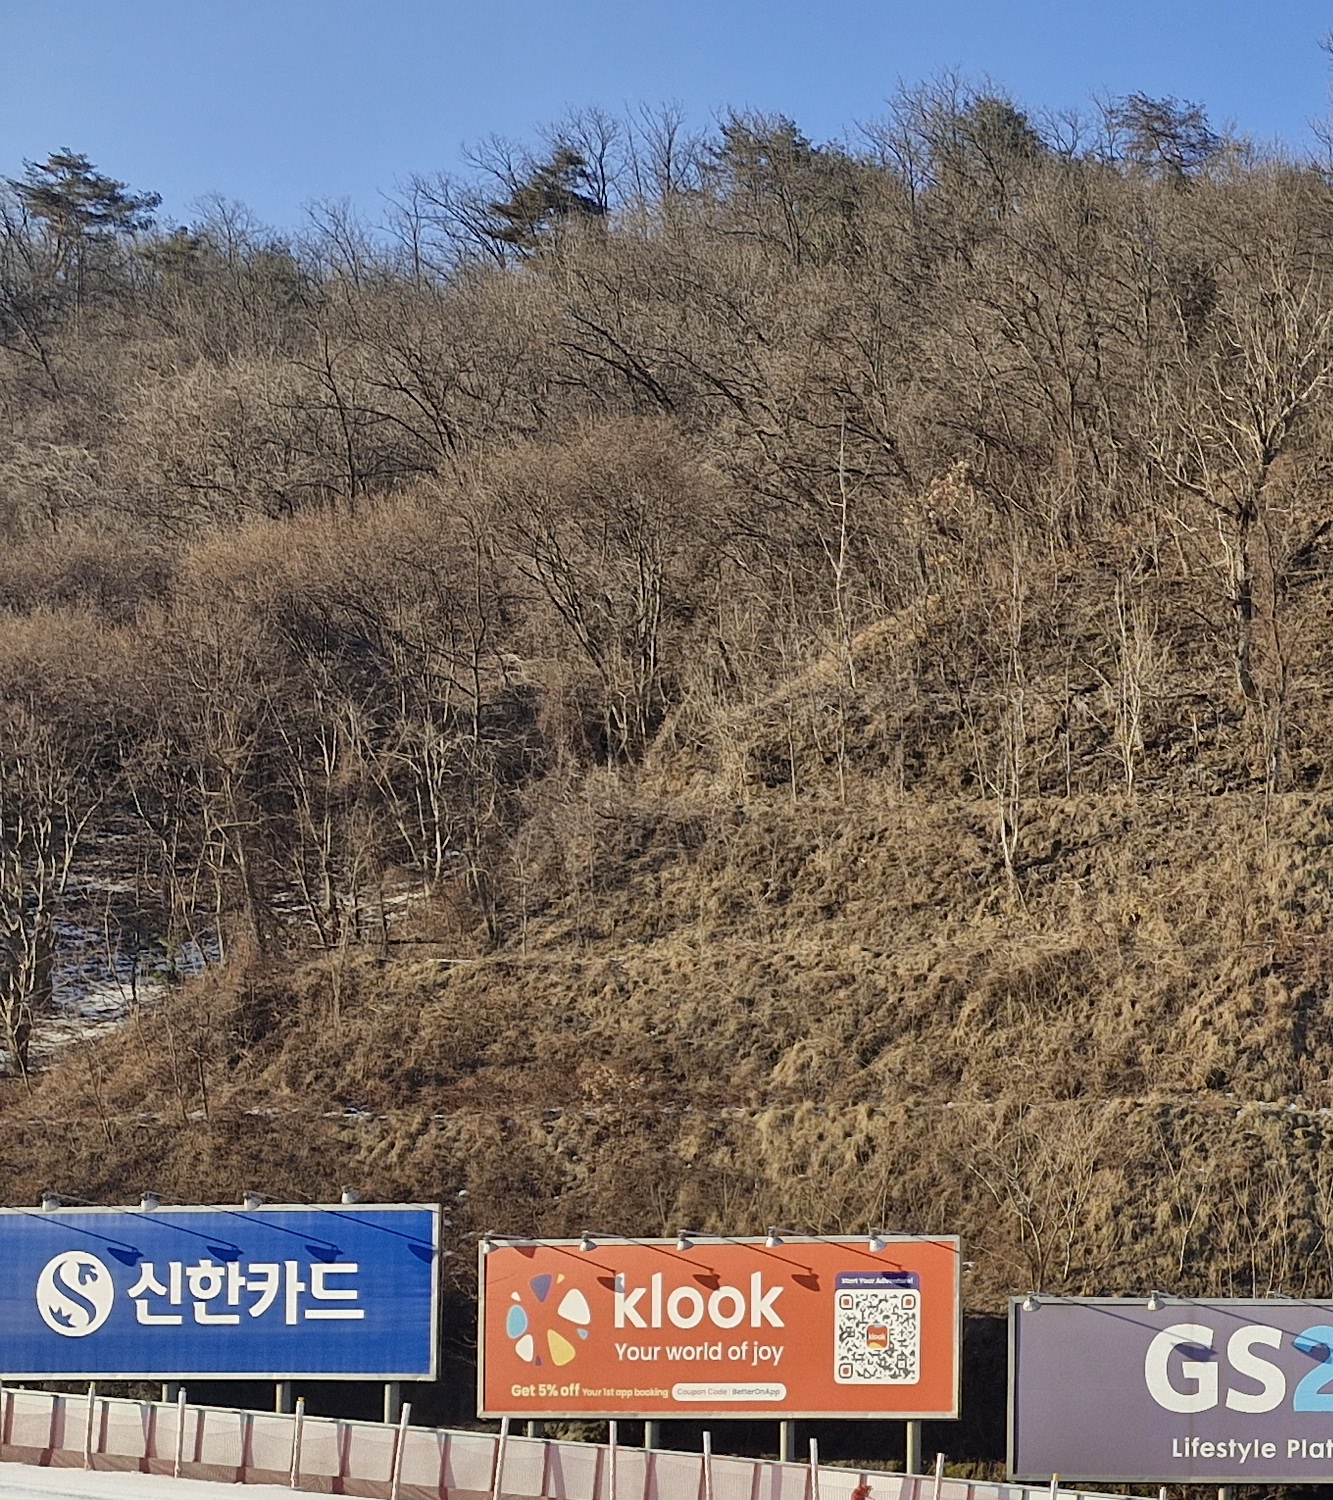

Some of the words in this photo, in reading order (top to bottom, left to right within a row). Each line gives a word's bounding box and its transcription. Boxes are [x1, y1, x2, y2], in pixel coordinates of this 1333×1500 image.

[127, 1259, 365, 1325] 신한카드
[614, 1271, 785, 1329] klook
[614, 1343, 661, 1361] Your
[666, 1342, 722, 1361] world
[728, 1341, 748, 1360] of
[752, 1342, 784, 1366] joy
[511, 1384, 536, 1397] Get
[538, 1384, 558, 1397] 5%
[560, 1383, 581, 1397] off
[616, 1389, 633, 1399] app
[634, 1387, 669, 1398] booking
[1172, 1438, 1277, 1463] Lifestyle
